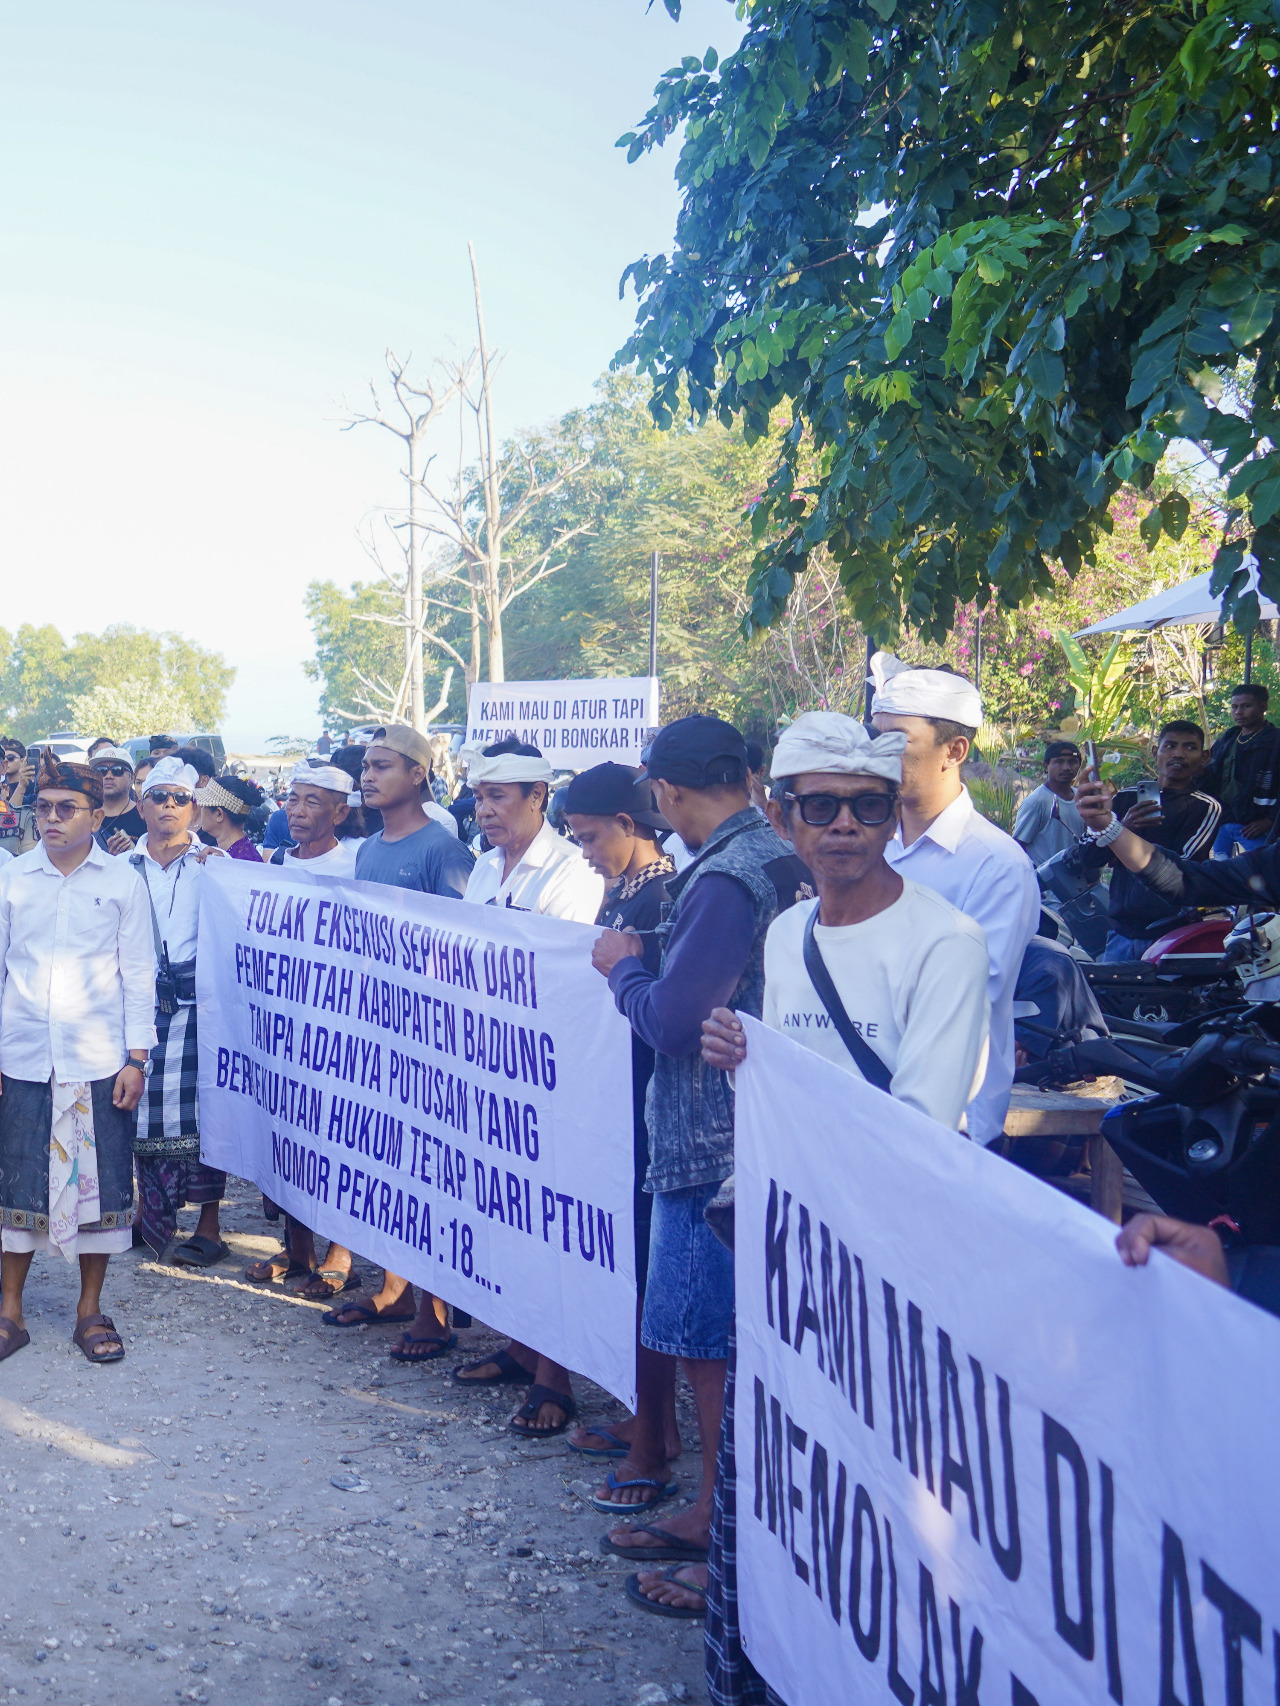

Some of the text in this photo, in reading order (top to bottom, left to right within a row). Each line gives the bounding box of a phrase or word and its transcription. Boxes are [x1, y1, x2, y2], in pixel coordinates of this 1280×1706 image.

[480, 698, 644, 721] KAMI MAU DI ATUR TAPI
[543, 728, 556, 748] DI
[561, 727, 629, 748] BONGKAR
[246, 889, 538, 1010] TOLAK EKSEKUSI SEPIHAK DARI
[235, 942, 557, 1092] PEMERINTAH KABUPATEN BADUNG
[783, 1013, 879, 1038] ANYWRE
[248, 1002, 540, 1162] TANPA ADANYA PUTUSAN YANG
[271, 1130, 331, 1204] NOMOR
[336, 1162, 432, 1256] PEKRARA
[327, 1095, 404, 1171] HUKUM
[410, 1125, 467, 1201] TETAP
[473, 1157, 533, 1236] DARI
[541, 1185, 615, 1274] PTUN
[765, 1177, 1280, 1706] KAMI MAU DI AT
